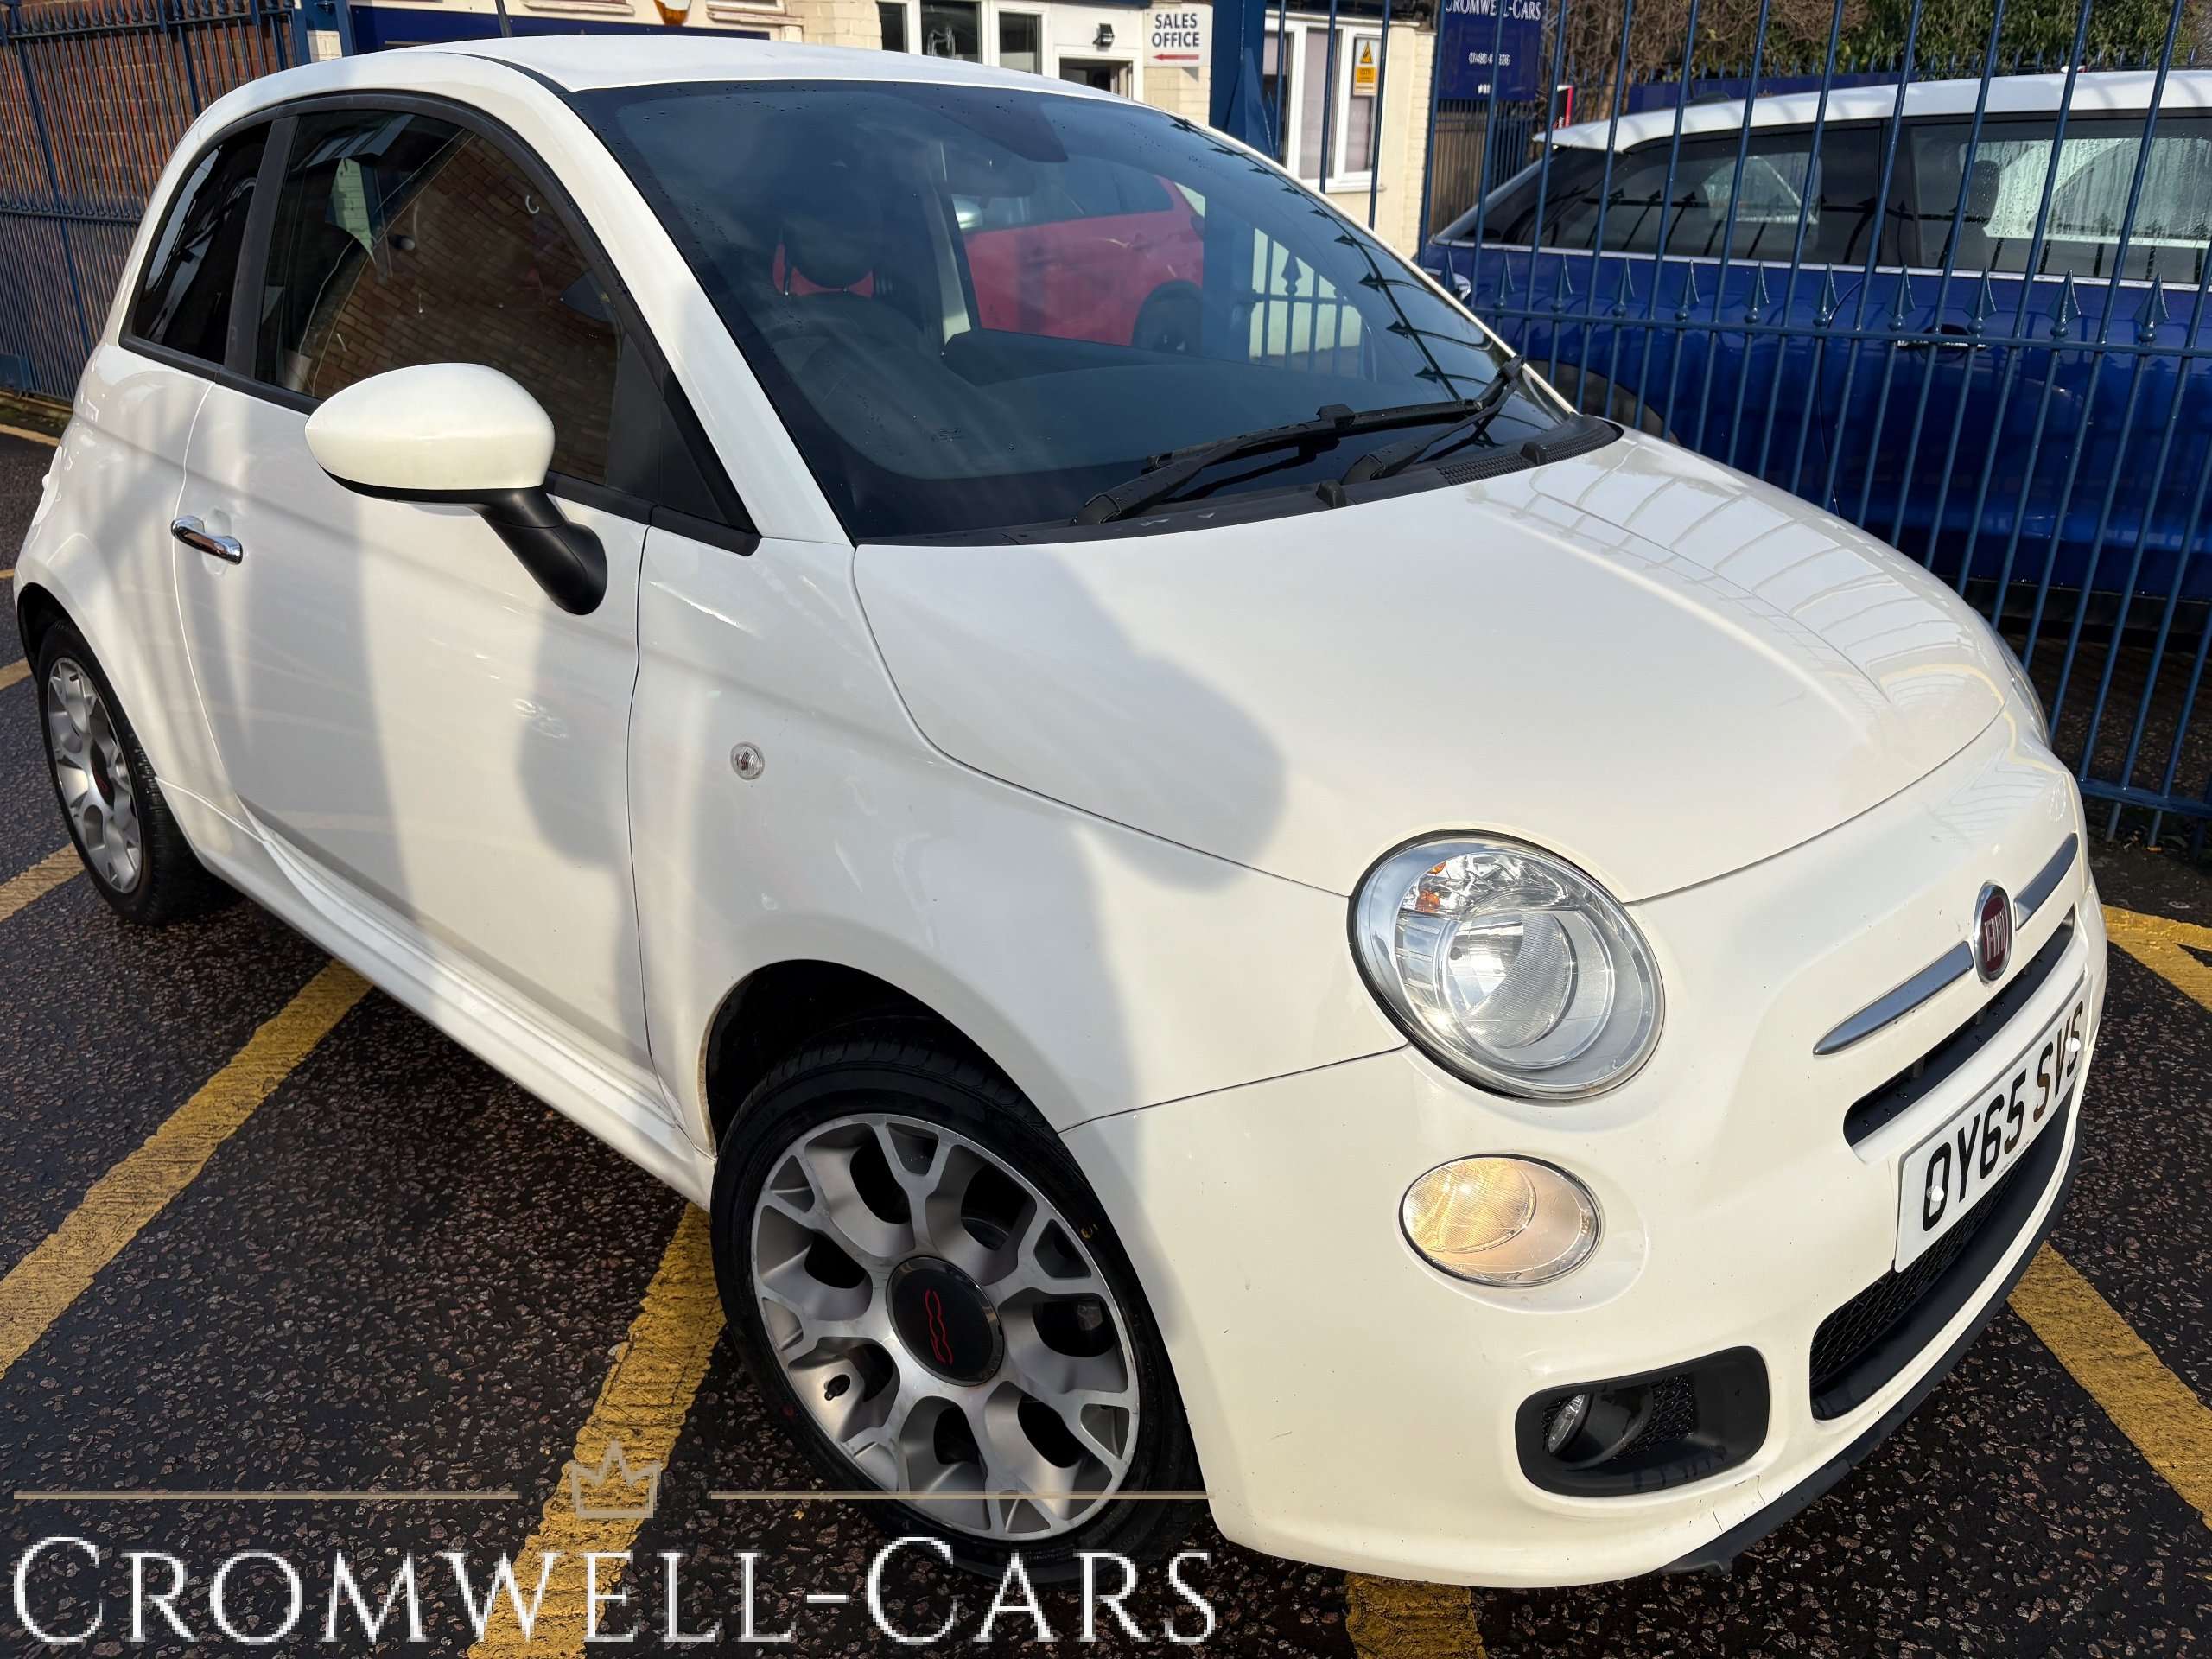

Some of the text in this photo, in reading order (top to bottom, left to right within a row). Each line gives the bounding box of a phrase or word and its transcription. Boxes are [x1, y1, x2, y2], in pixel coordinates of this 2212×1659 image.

[1154, 12, 1198, 29] SALES
[1445, 0, 1541, 21] ROMWEL-CARS
[1152, 31, 1200, 48] OFFICE
[1984, 906, 2006, 962] FIAT
[1922, 1068, 2027, 1232] OY65
[2033, 1001, 2084, 1123] SVS
